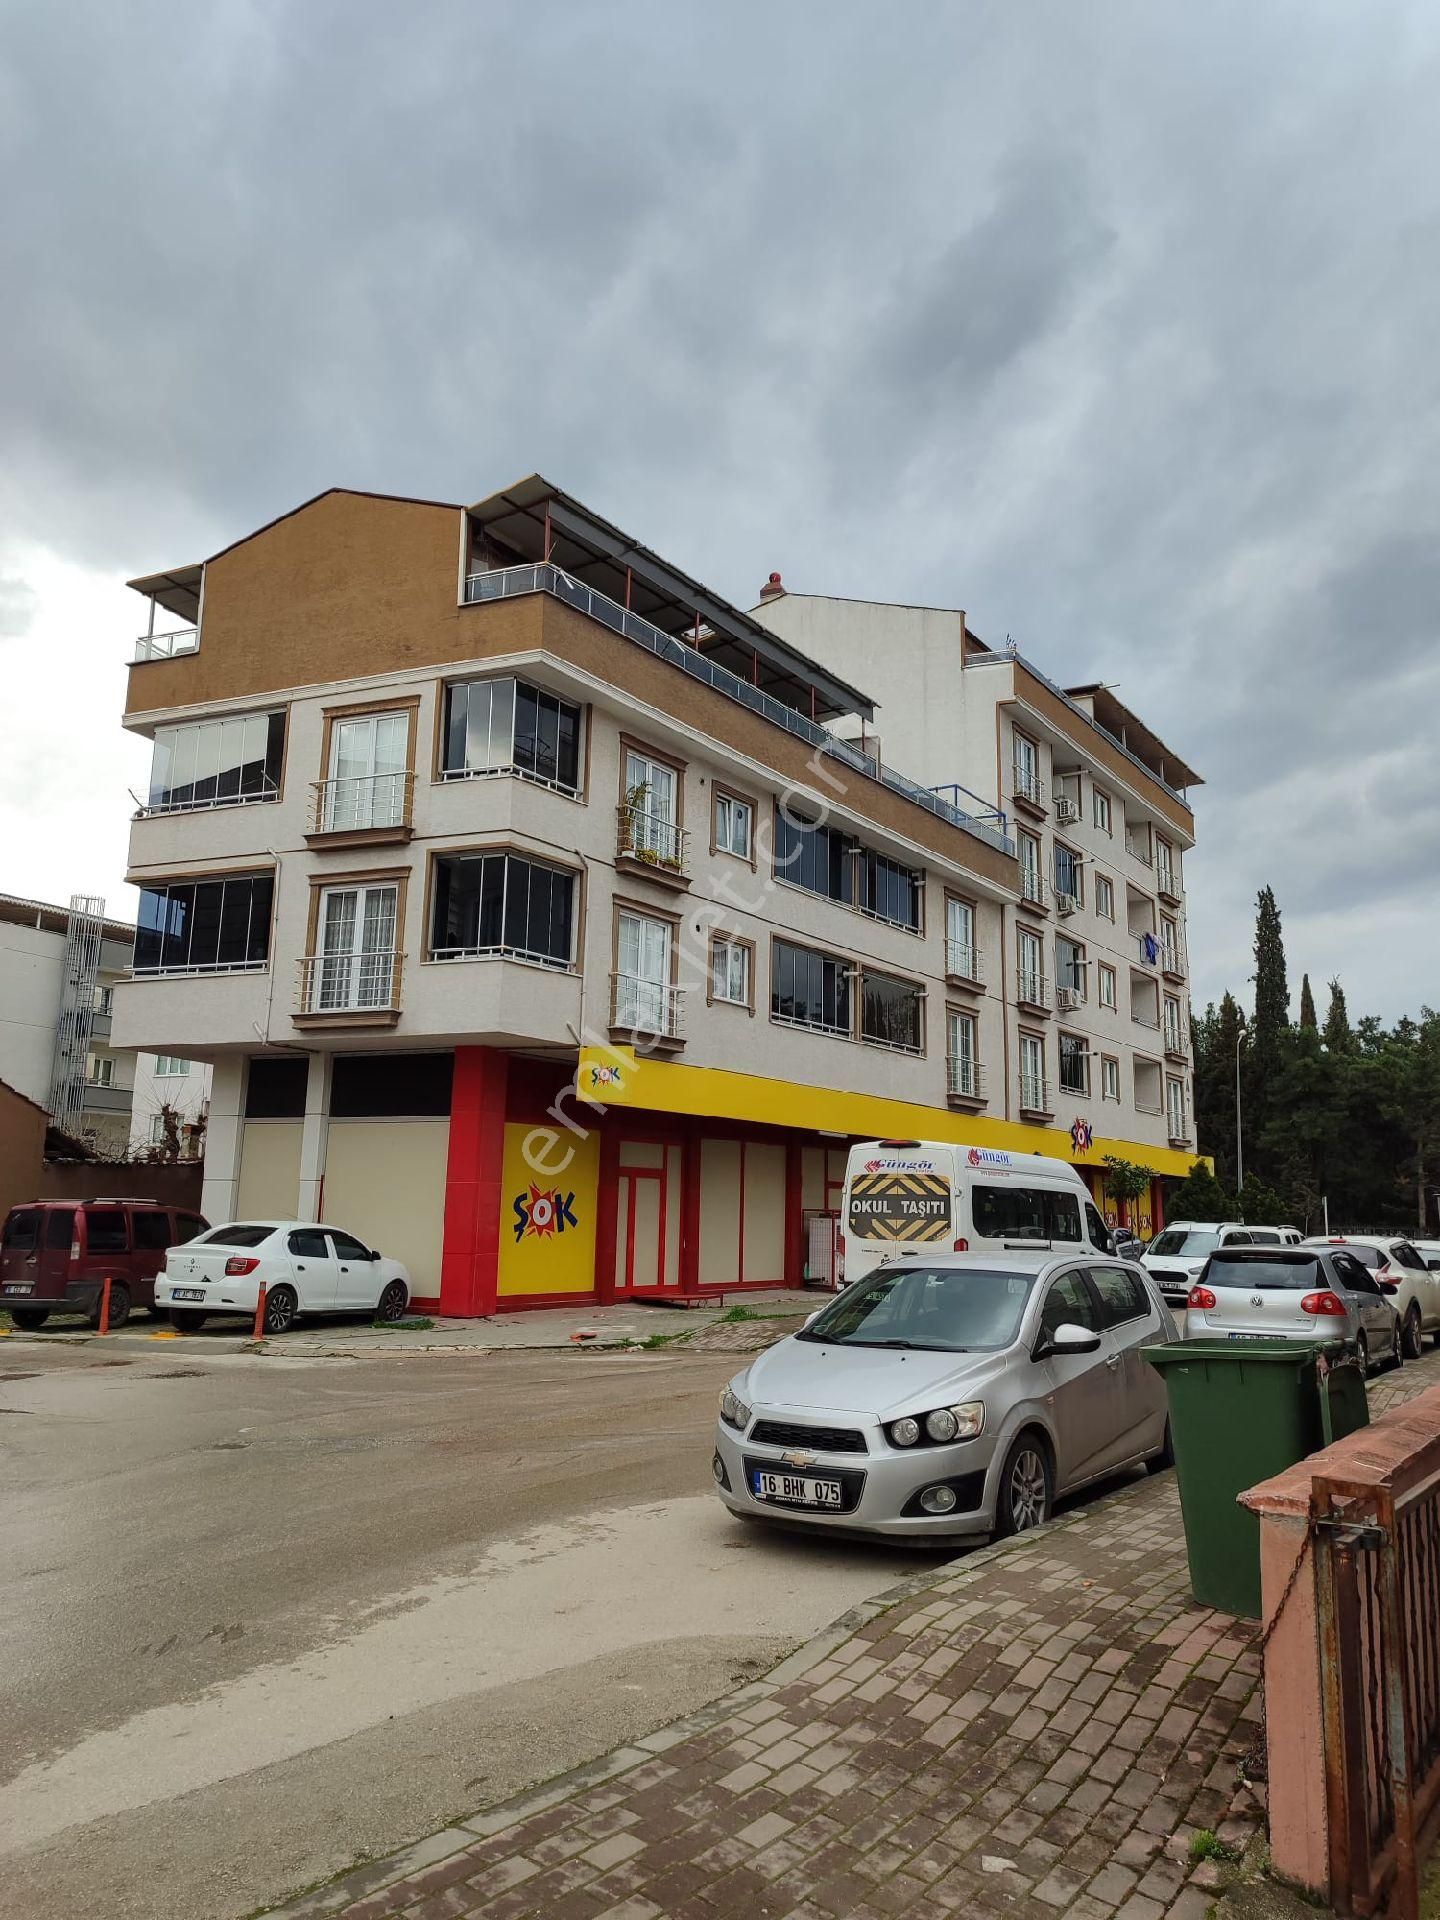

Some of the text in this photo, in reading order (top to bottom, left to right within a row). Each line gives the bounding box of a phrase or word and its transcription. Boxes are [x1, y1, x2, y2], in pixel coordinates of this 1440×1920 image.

[513, 1191, 578, 1243] ŞOK
[851, 1201, 945, 1218] OKUL TAŞITI
[762, 1475, 776, 1492] 16
[783, 1477, 806, 1498] BHK
[814, 1482, 840, 1501] 075
